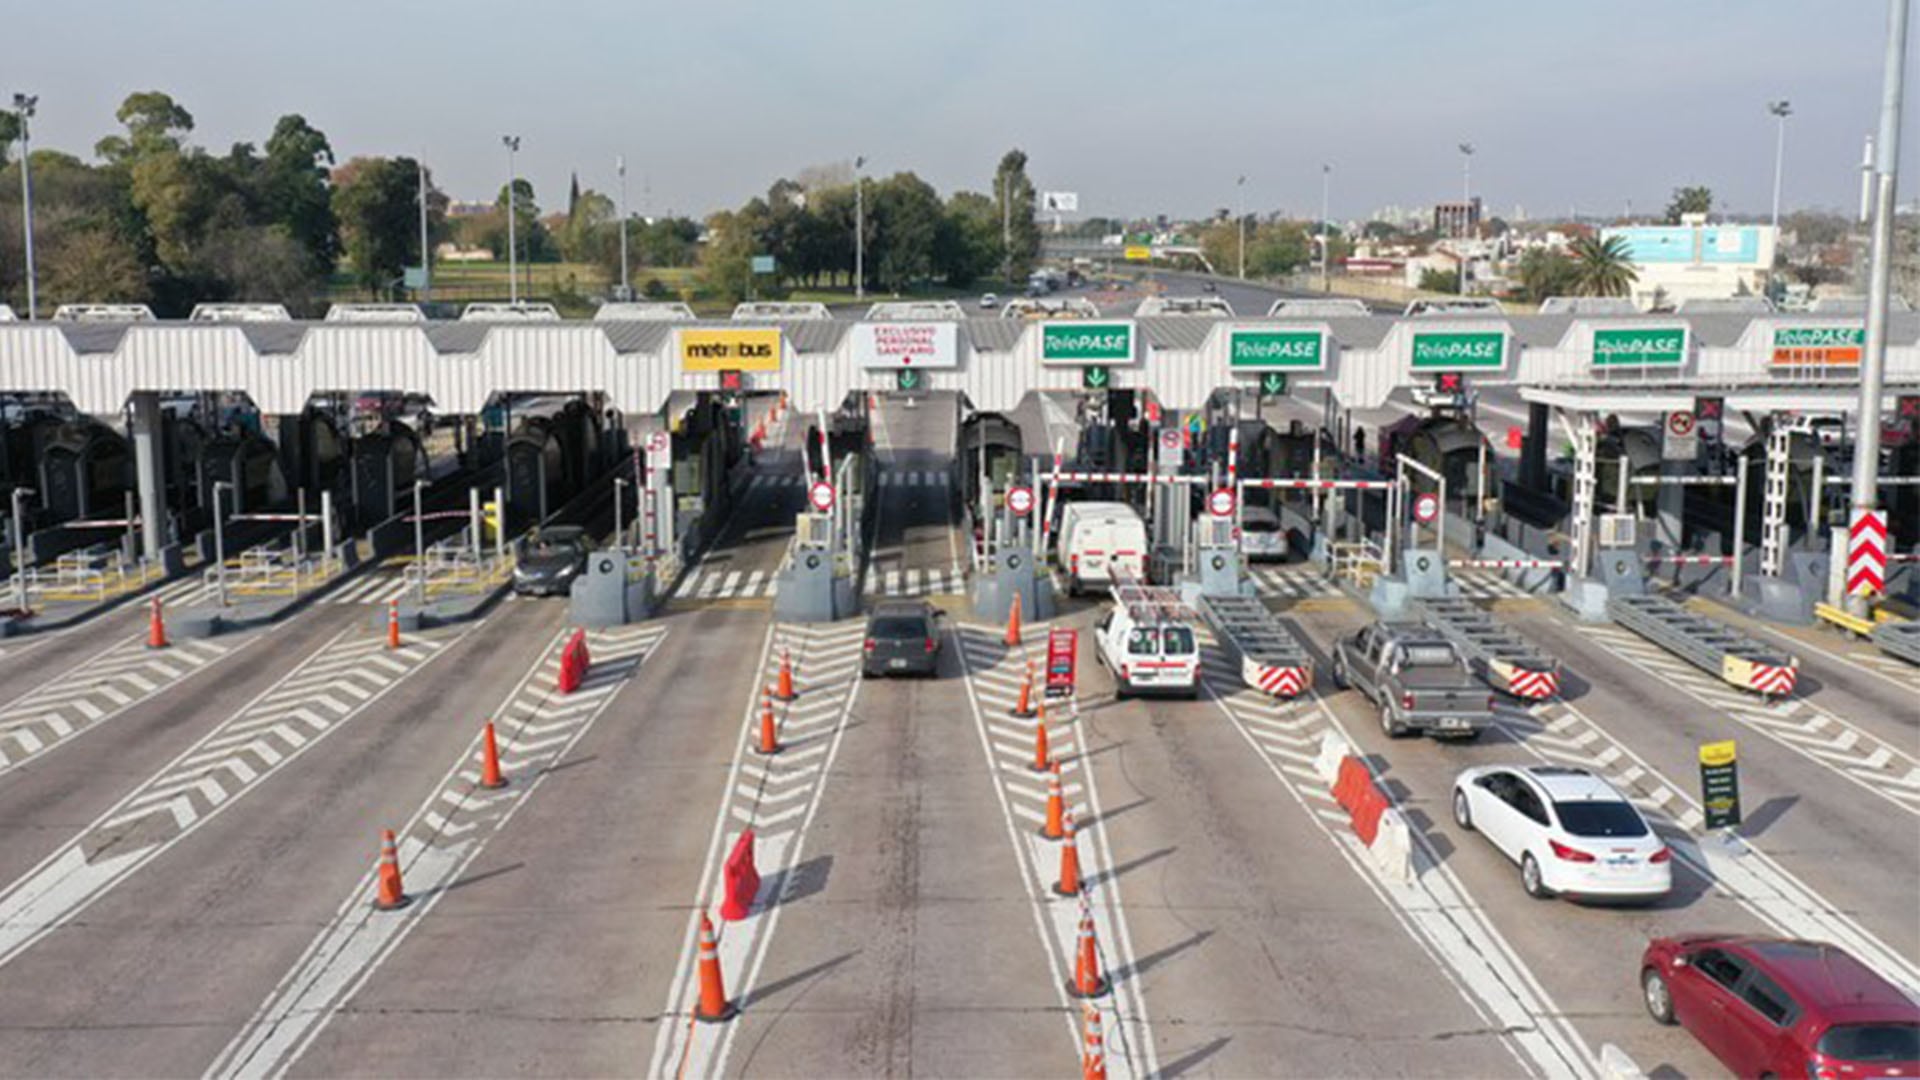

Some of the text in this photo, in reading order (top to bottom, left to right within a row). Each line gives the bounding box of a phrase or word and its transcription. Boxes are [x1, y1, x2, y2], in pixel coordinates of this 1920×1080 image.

[874, 326, 936, 336] EXCLUSIVO
[875, 337, 935, 346] PERSONAL
[1046, 335, 1126, 351] TelePASE
[1597, 339, 1678, 353] TelePASE
[876, 346, 936, 355] SANITARIO
[1235, 341, 1317, 357] TelePASE
[1416, 341, 1498, 358] TelePASE
